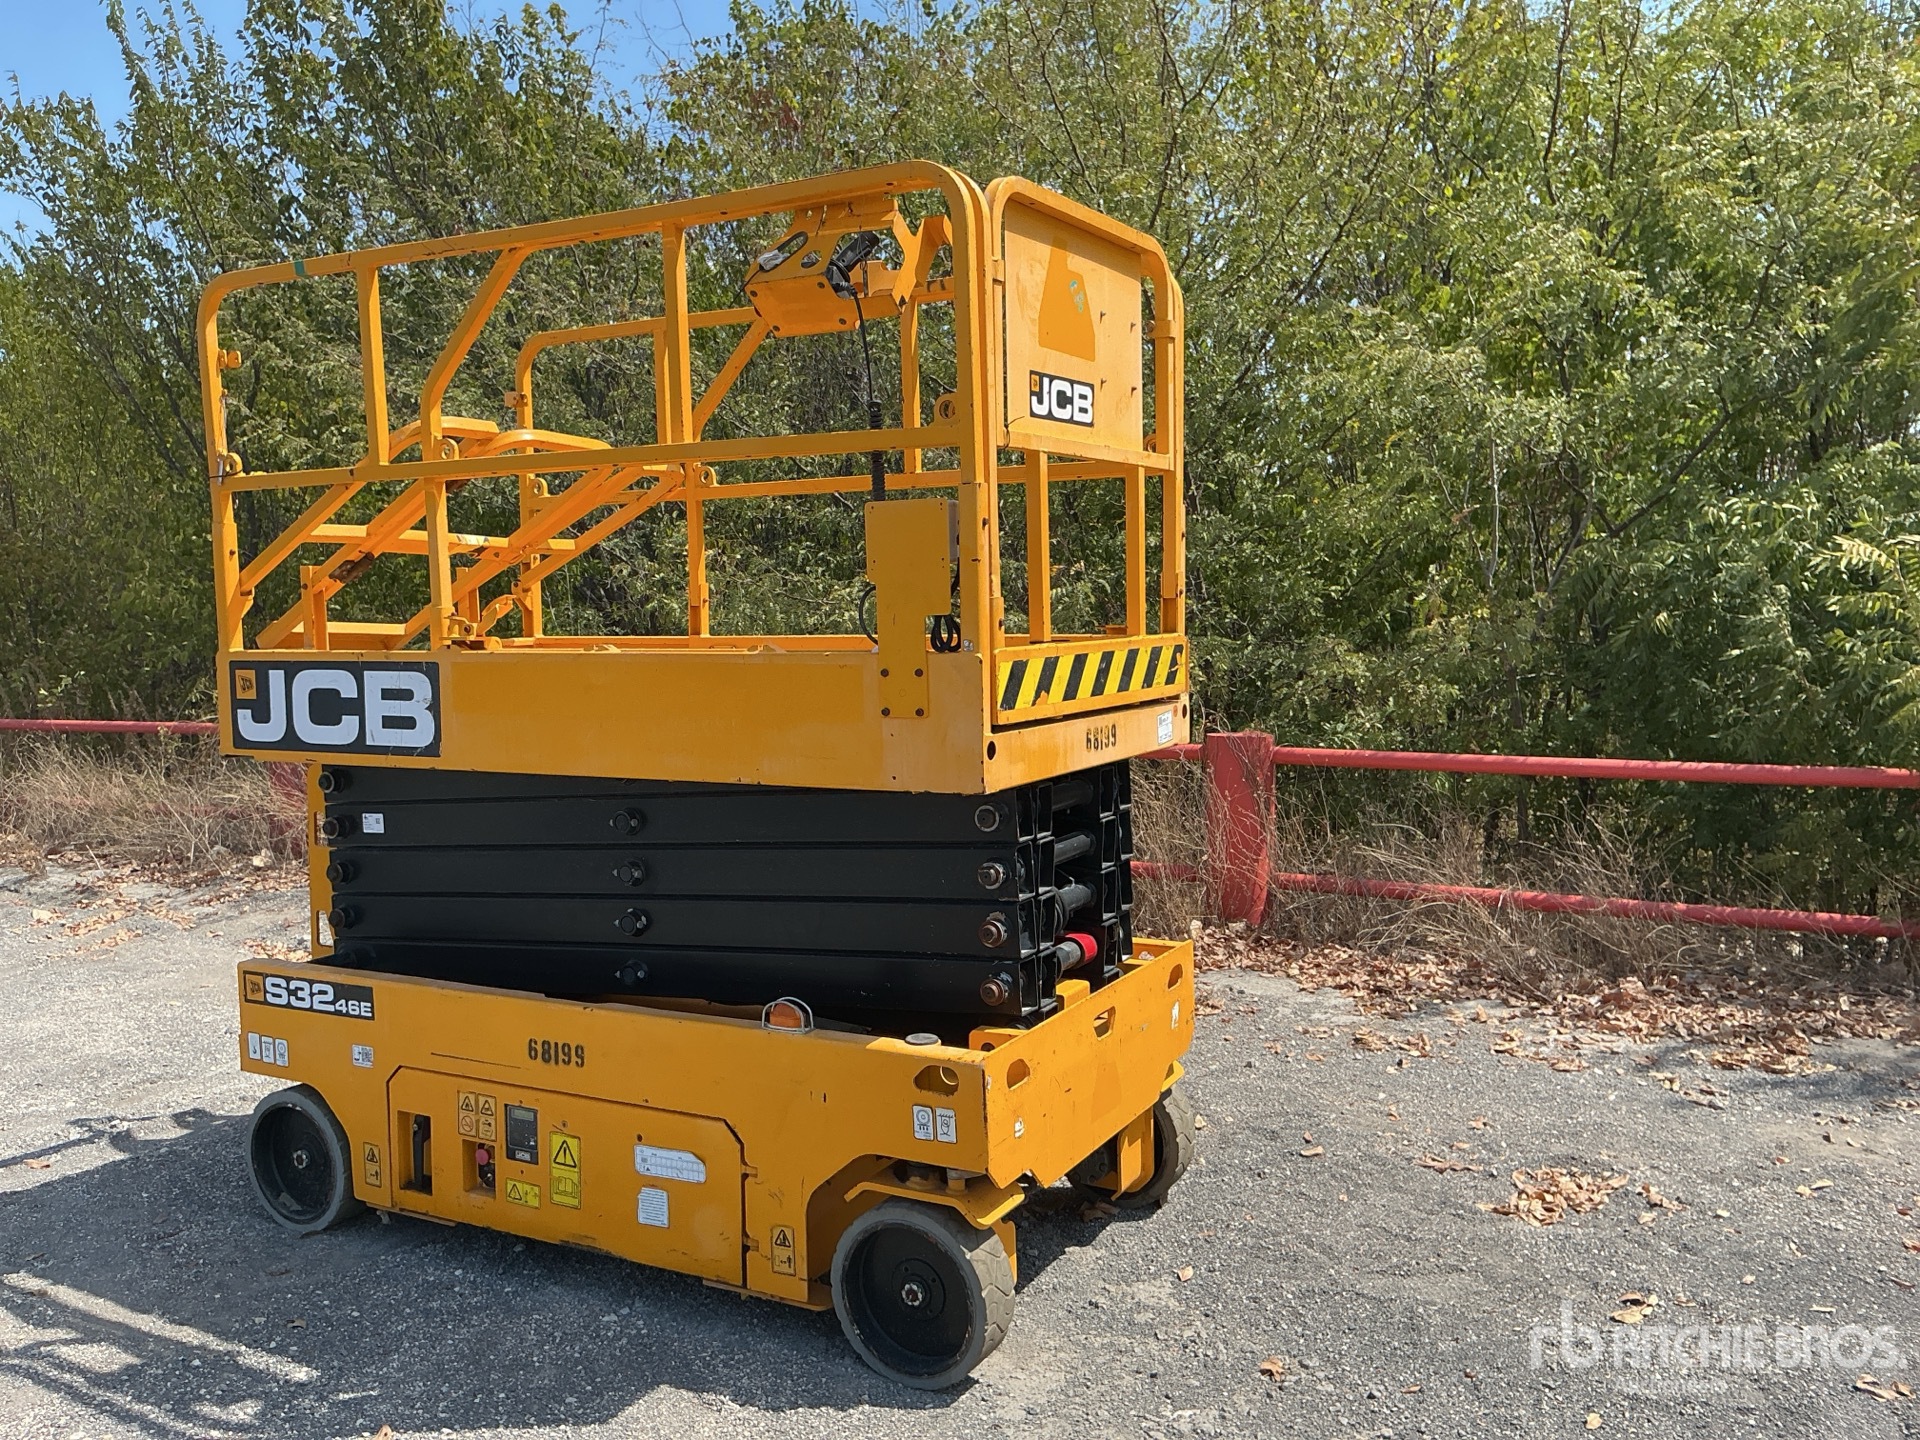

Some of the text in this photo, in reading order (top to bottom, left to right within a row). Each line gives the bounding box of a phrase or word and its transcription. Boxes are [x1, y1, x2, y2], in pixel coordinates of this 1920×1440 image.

[1031, 376, 1093, 423] JCB
[236, 669, 435, 748] JCB
[1085, 723, 1117, 752] 68199
[528, 1037, 585, 1068] 68199
